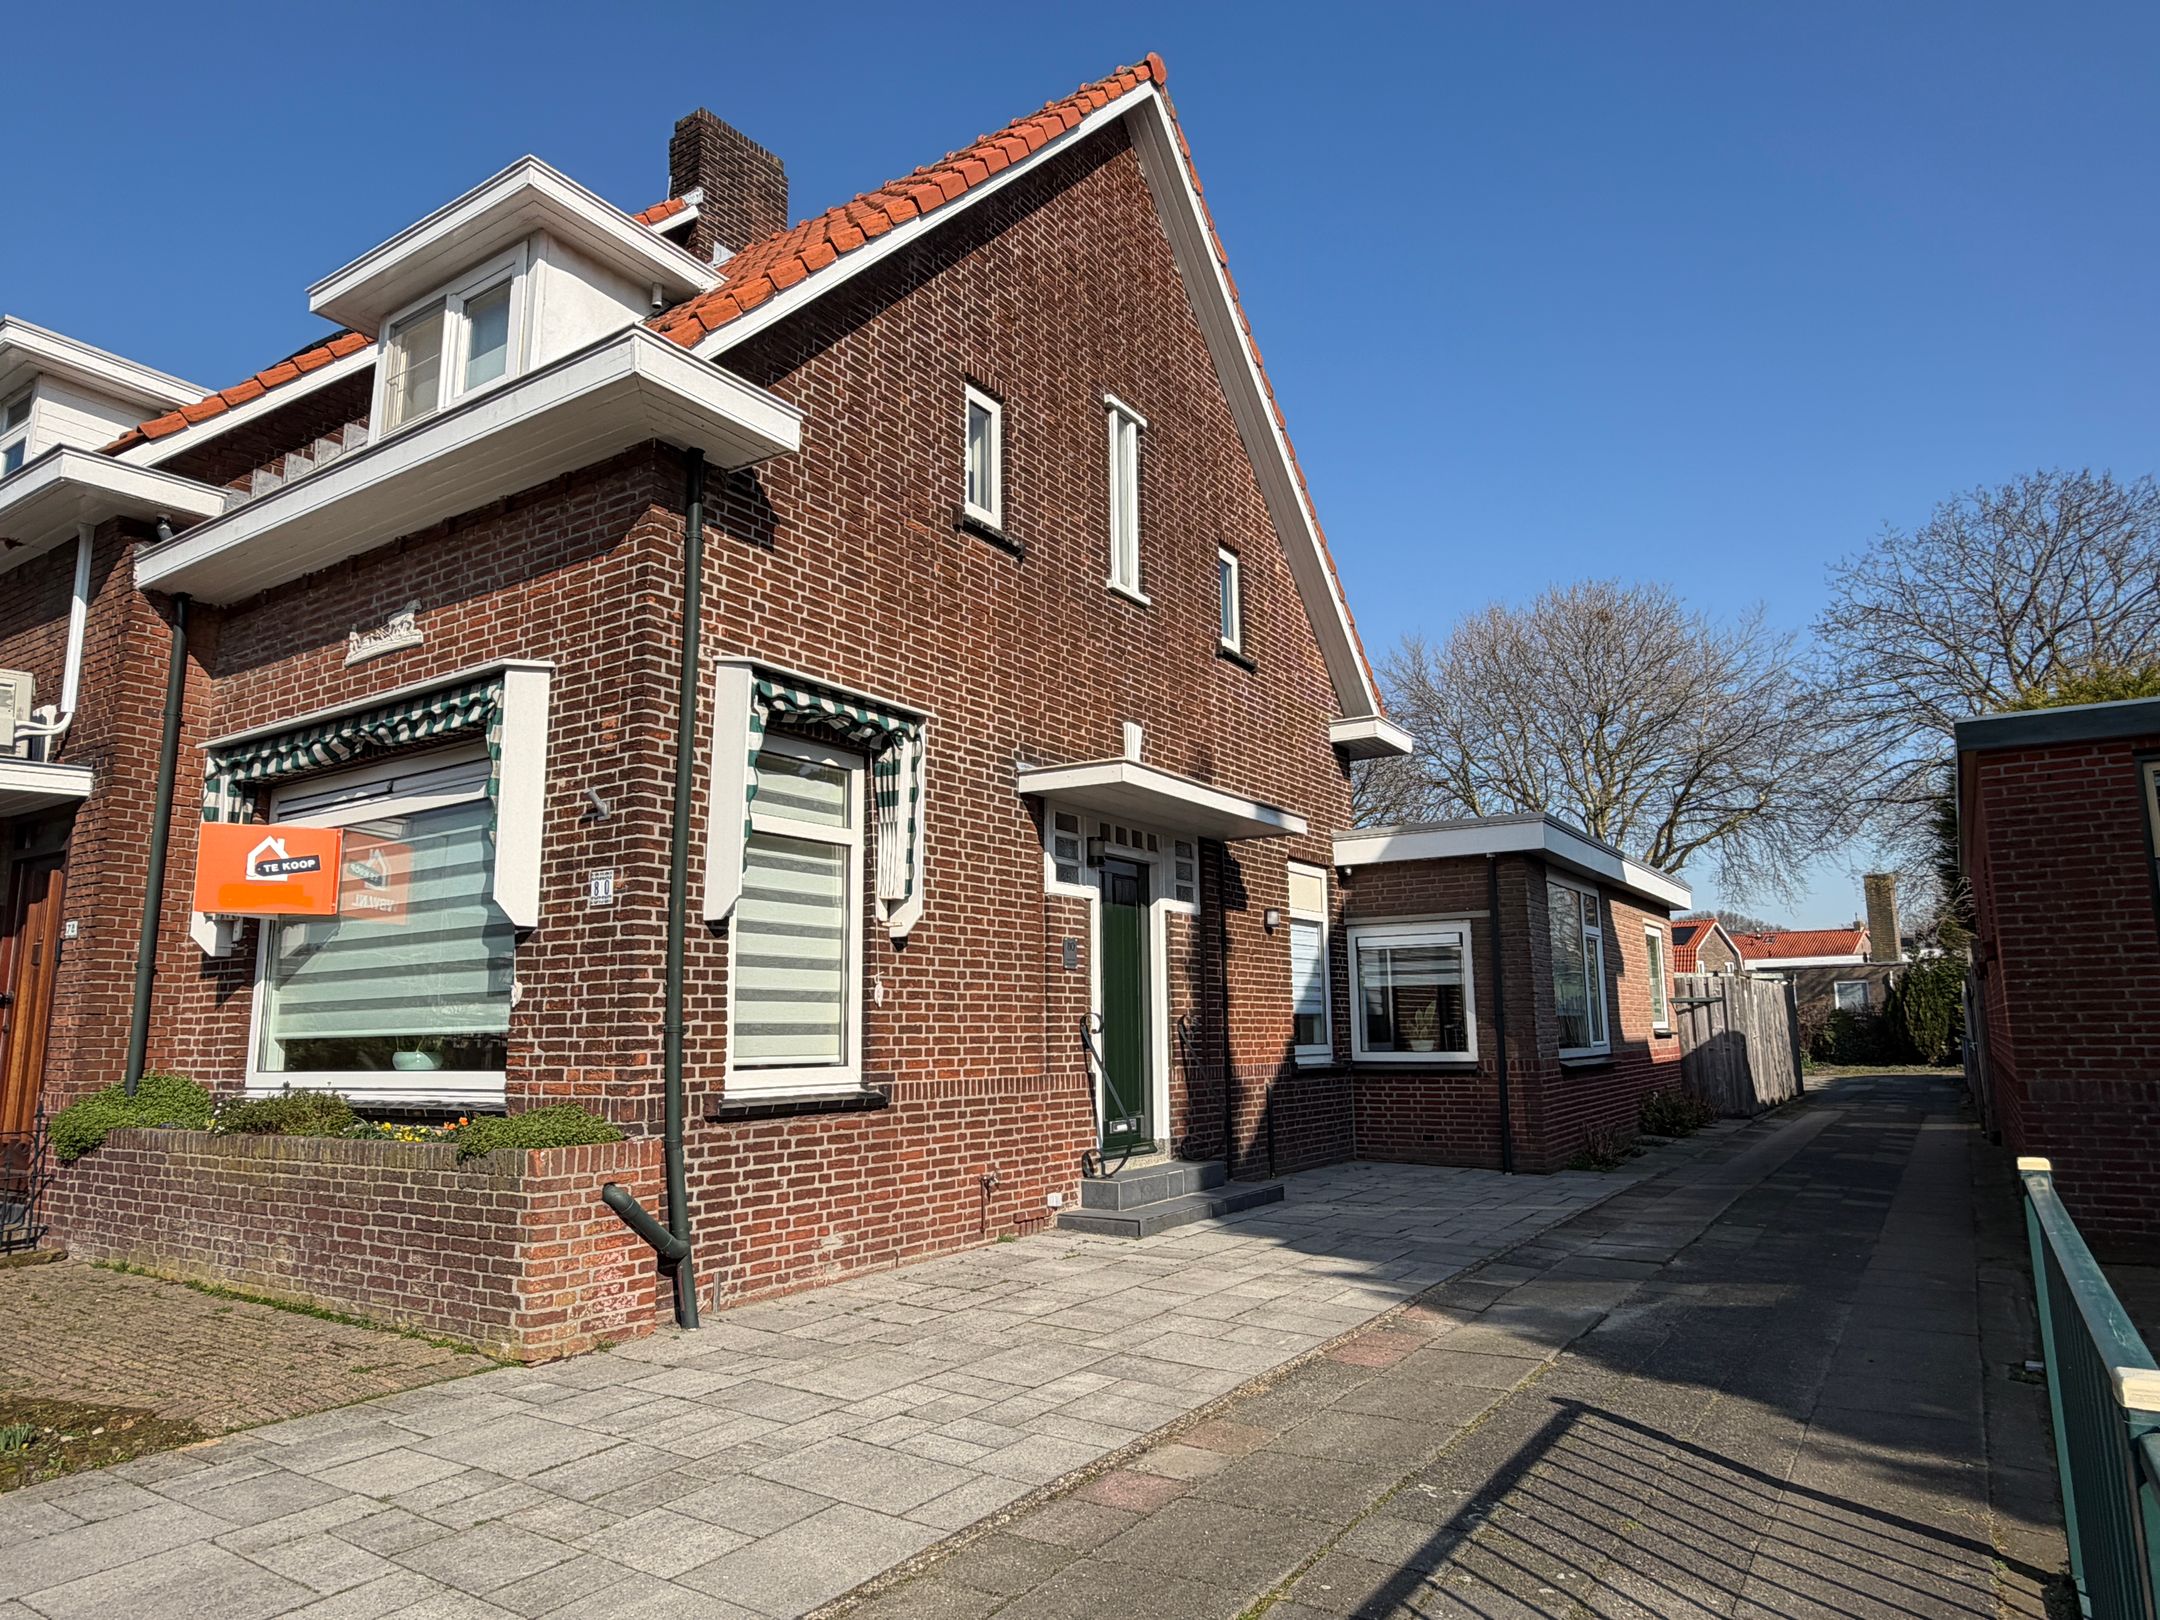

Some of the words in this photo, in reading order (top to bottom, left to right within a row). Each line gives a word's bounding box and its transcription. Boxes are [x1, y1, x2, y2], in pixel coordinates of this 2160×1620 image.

[263, 863, 279, 873] TE
[282, 859, 316, 871] KOOP
[594, 880, 610, 896] 80
